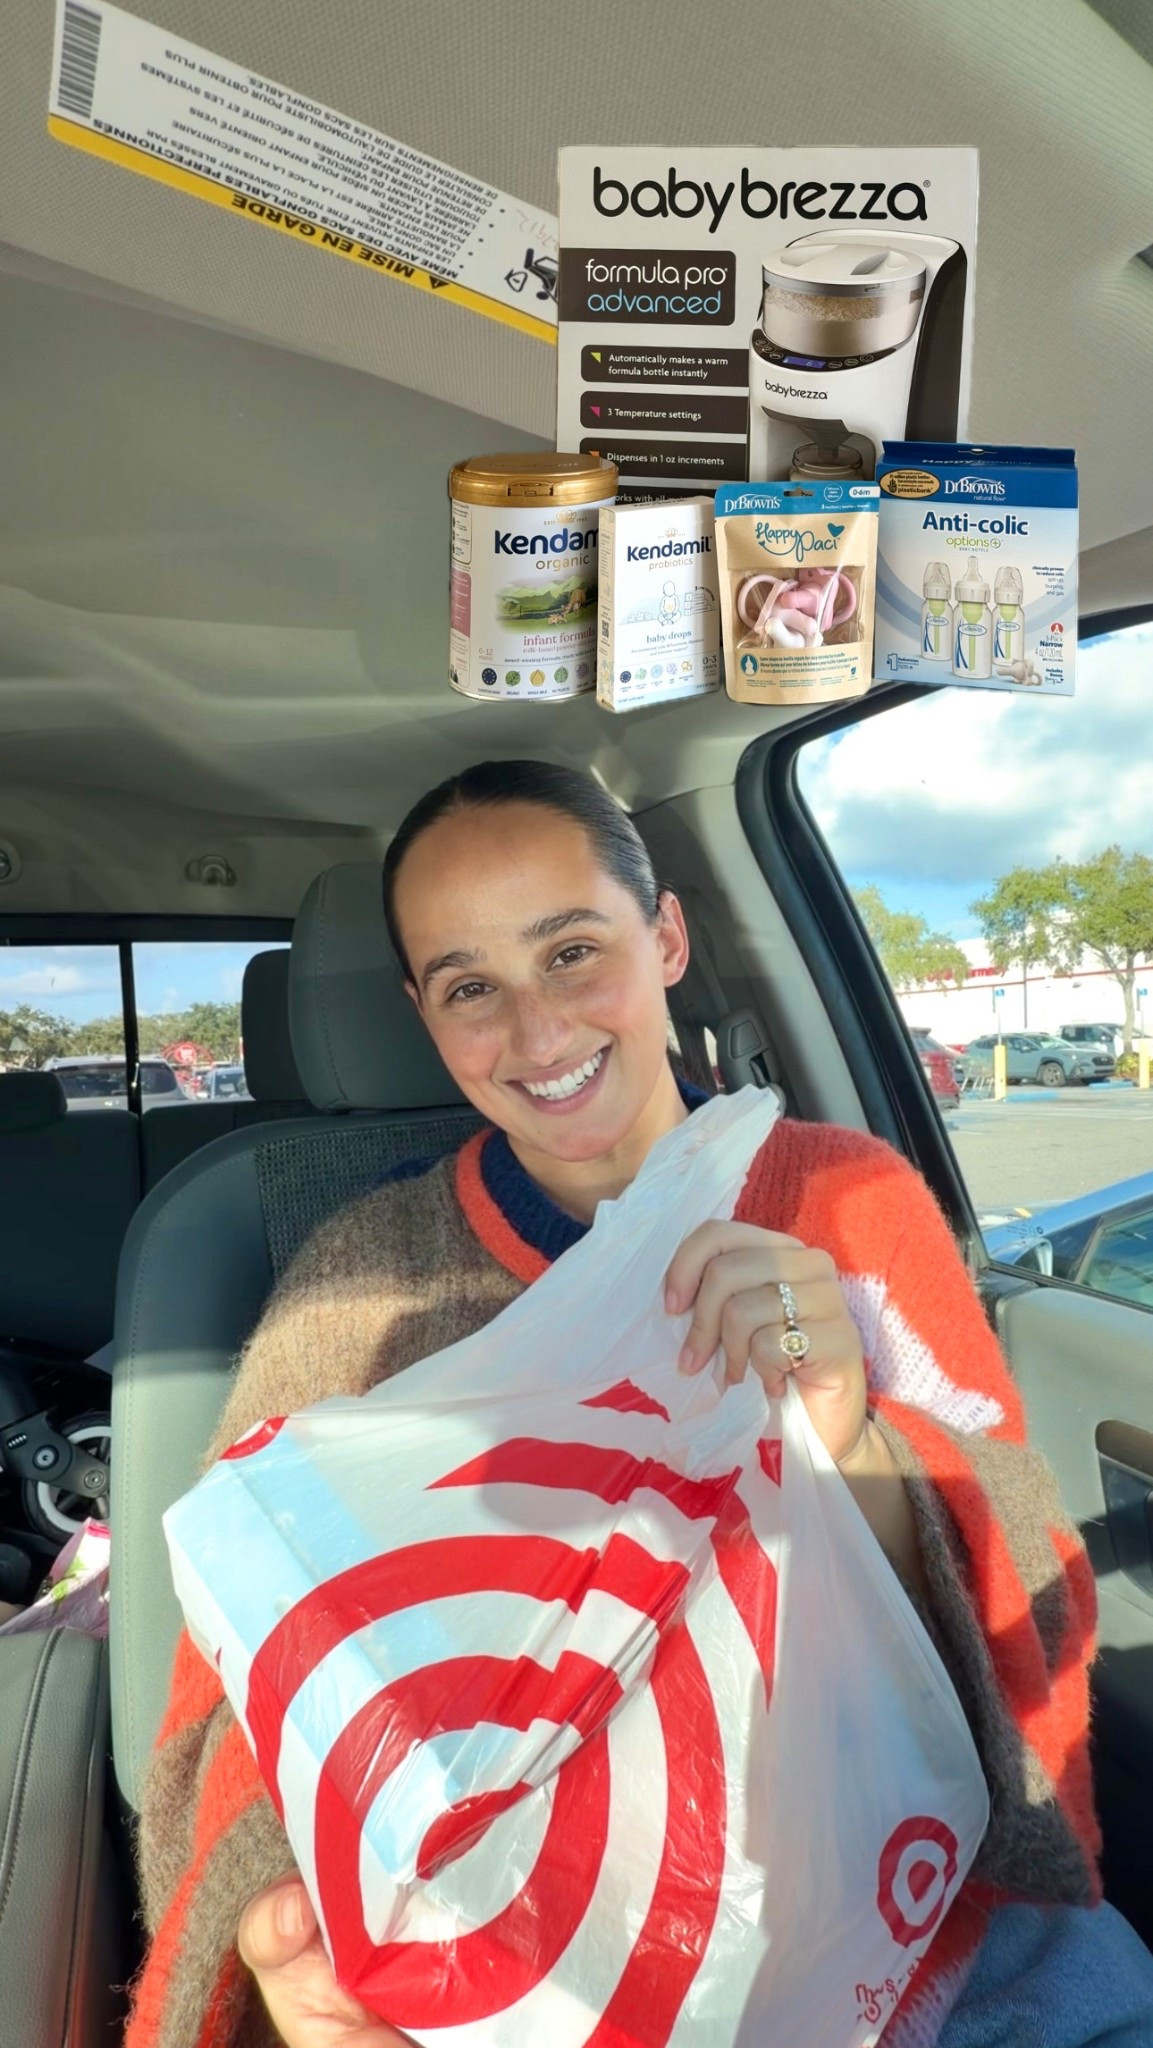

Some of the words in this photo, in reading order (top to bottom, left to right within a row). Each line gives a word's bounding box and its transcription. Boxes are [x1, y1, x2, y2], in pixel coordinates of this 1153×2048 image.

[164, 48, 195, 70] PLUS
[139, 61, 201, 98] SYSTÈMES
[198, 64, 249, 94] OBTENIR
[203, 90, 224, 106] LES
[226, 101, 240, 113] ET
[250, 89, 282, 110] POUR
[188, 105, 218, 124] VERS
[323, 111, 351, 130] SACS
[242, 108, 294, 140] SÉCURITÉ
[352, 125, 372, 140] LES
[146, 128, 168, 143] PAR
[171, 119, 241, 157] SÉCURITAIRE
[220, 120, 267, 148] ORIENTÉ
[295, 132, 311, 145] DE
[373, 135, 396, 151] SUR
[92, 117, 221, 181] PERFECTIONNÉS
[170, 138, 216, 165] BLESSÉS
[268, 141, 309, 165] ENFANT
[312, 140, 369, 172] CEINTURES
[376, 148, 390, 160] DE
[243, 150, 270, 168] PLUS
[392, 156, 423, 175] GUIDE
[218, 159, 280, 191] GRAVEMENT
[272, 163, 285, 174] LA
[310, 160, 339, 178] POUR
[370, 167, 389, 180] LES
[396, 146, 484, 193] RENSEIGNEMENTS
[424, 170, 437, 181] LE
[287, 170, 319, 189] PLACE
[340, 174, 369, 193] SIÈGE
[369, 177, 384, 188] DU
[390, 176, 433, 200] UTILISER
[401, 170, 429, 189] POUR
[224, 174, 318, 220] GONFLABLES
[282, 187, 298, 198] OU
[321, 185, 334, 196] LA
[335, 191, 353, 204] EST
[370, 187, 386, 199] UN
[386, 184, 423, 206] L'AVANT
[430, 184, 473, 209] RETENUE
[437, 177, 493, 207] CONSULTER
[484, 188, 498, 200] DE
[299, 194, 324, 212] TUÉS
[353, 199, 393, 223] ARRIÈRE
[386, 194, 423, 216] PLACER
[423, 202, 431, 211] À
[433, 195, 481, 222] TOUJOURS
[473, 204, 487, 215] DE
[231, 192, 316, 238] GARDE
[325, 206, 349, 222] ÊTRE
[424, 211, 456, 230] JAMAIS
[319, 215, 355, 236] SACS
[351, 216, 393, 239] PEUVENT
[394, 217, 448, 245] BANQUETTE
[422, 220, 439, 232] LES
[456, 226, 471, 237] NE
[321, 231, 354, 253] EN
[356, 230, 383, 248] DES
[423, 239, 441, 251] SAC
[440, 228, 465, 244] POUR
[384, 242, 419, 263] AVEC
[394, 235, 434, 257] ENFANTS
[442, 247, 456, 257] UN
[448, 241, 460, 251] LA
[357, 246, 414, 278] MISE
[434, 253, 451, 264] LES
[419, 258, 458, 281] MÊME
[585, 258, 680, 284] formula
[587, 288, 721, 314] advanced
[608, 354, 667, 366] Automatically
[669, 356, 696, 365] makes
[608, 366, 641, 376] formula
[643, 367, 670, 377] bottle
[671, 369, 709, 380] instantly
[607, 407, 613, 416] 3
[614, 408, 667, 419] Temperature
[668, 411, 702, 421] settings
[606, 452, 648, 464] Dispenses
[650, 454, 658, 463] in
[660, 454, 664, 463] 1
[677, 456, 725, 466] increments
[614, 493, 633, 502] orks
[634, 494, 653, 502] with
[852, 488, 871, 496] 0-6m
[922, 511, 1029, 536] Anti-colic
[755, 522, 800, 552] Happy
[626, 536, 712, 562] Kendamil
[536, 554, 590, 572] organic
[648, 557, 693, 572] probiotics
[523, 634, 557, 646] infant
[646, 634, 666, 644] baby
[668, 629, 692, 641] drops
[1039, 640, 1063, 648] Narrow
[478, 647, 494, 656] 0-12
[702, 655, 717, 665] 0-3
